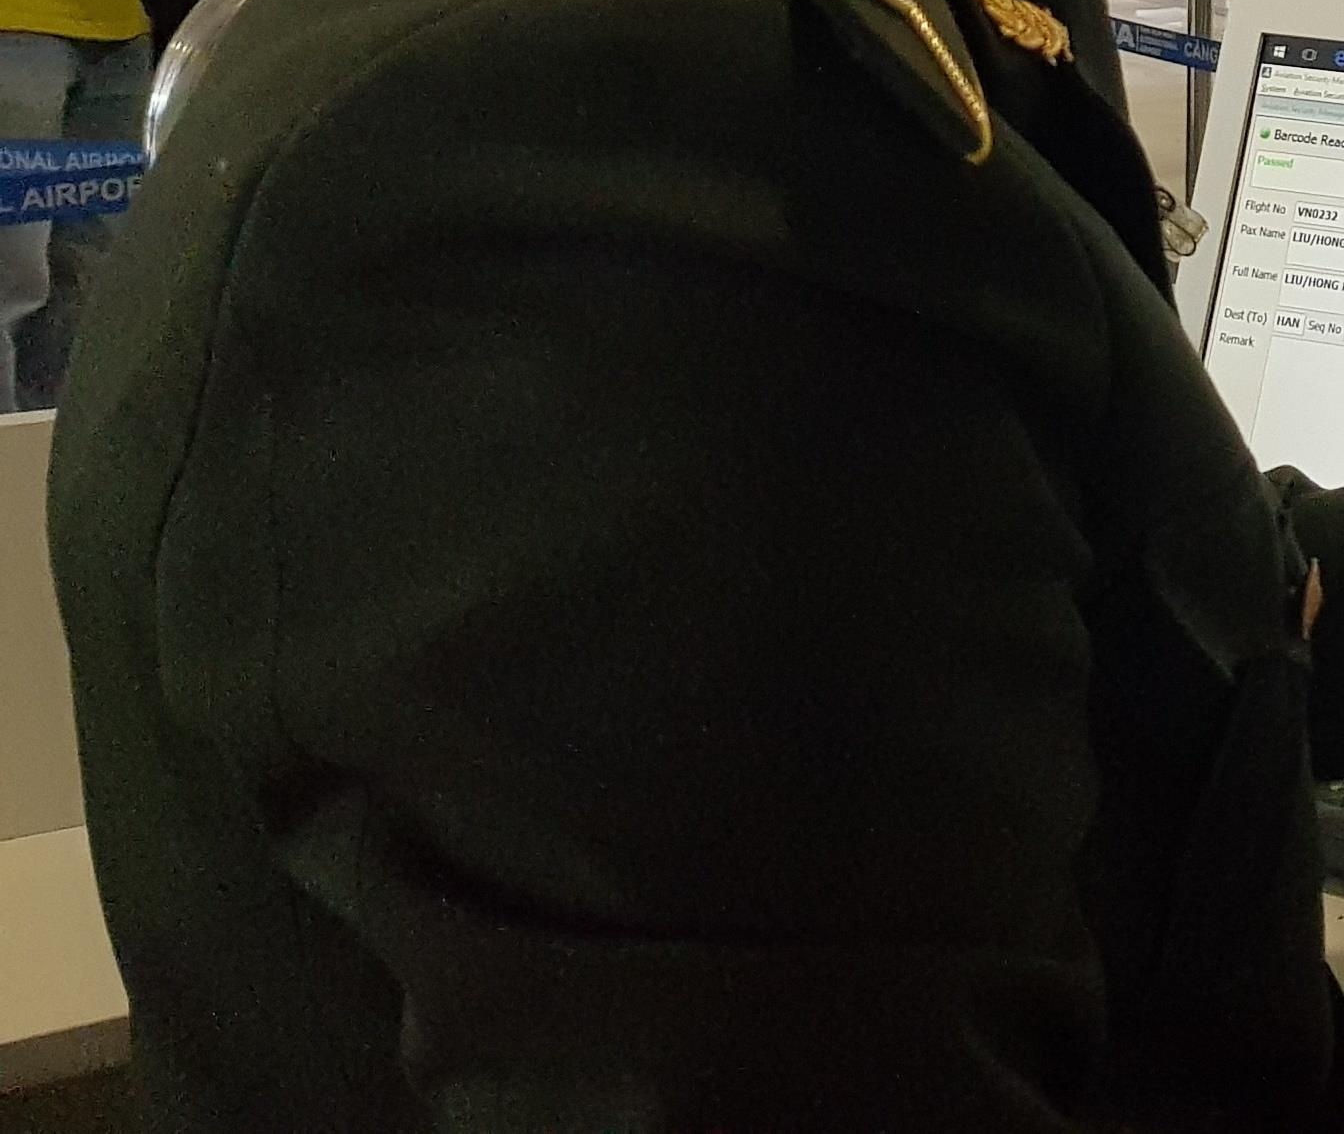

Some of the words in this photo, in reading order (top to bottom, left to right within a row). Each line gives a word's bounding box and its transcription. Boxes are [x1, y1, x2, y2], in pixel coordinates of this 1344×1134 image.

[1261, 83, 1287, 93] System
[1274, 129, 1317, 145] Barcode
[1257, 155, 1294, 169] Passed
[1245, 199, 1270, 214] Flight
[1272, 203, 1286, 215] No
[1297, 206, 1338, 222] VN0232
[1240, 224, 1257, 236] Pax
[1258, 227, 1286, 240] Name
[1232, 265, 1250, 277] Full
[1251, 268, 1279, 282] Name
[1284, 273, 1339, 291] LIU/HONG
[1224, 308, 1245, 321] Dest
[1246, 310, 1268, 325] (To)
[1276, 315, 1300, 329] HAN
[1308, 320, 1326, 335] Seq
[1327, 323, 1342, 334] No
[1219, 332, 1255, 348] Remark
